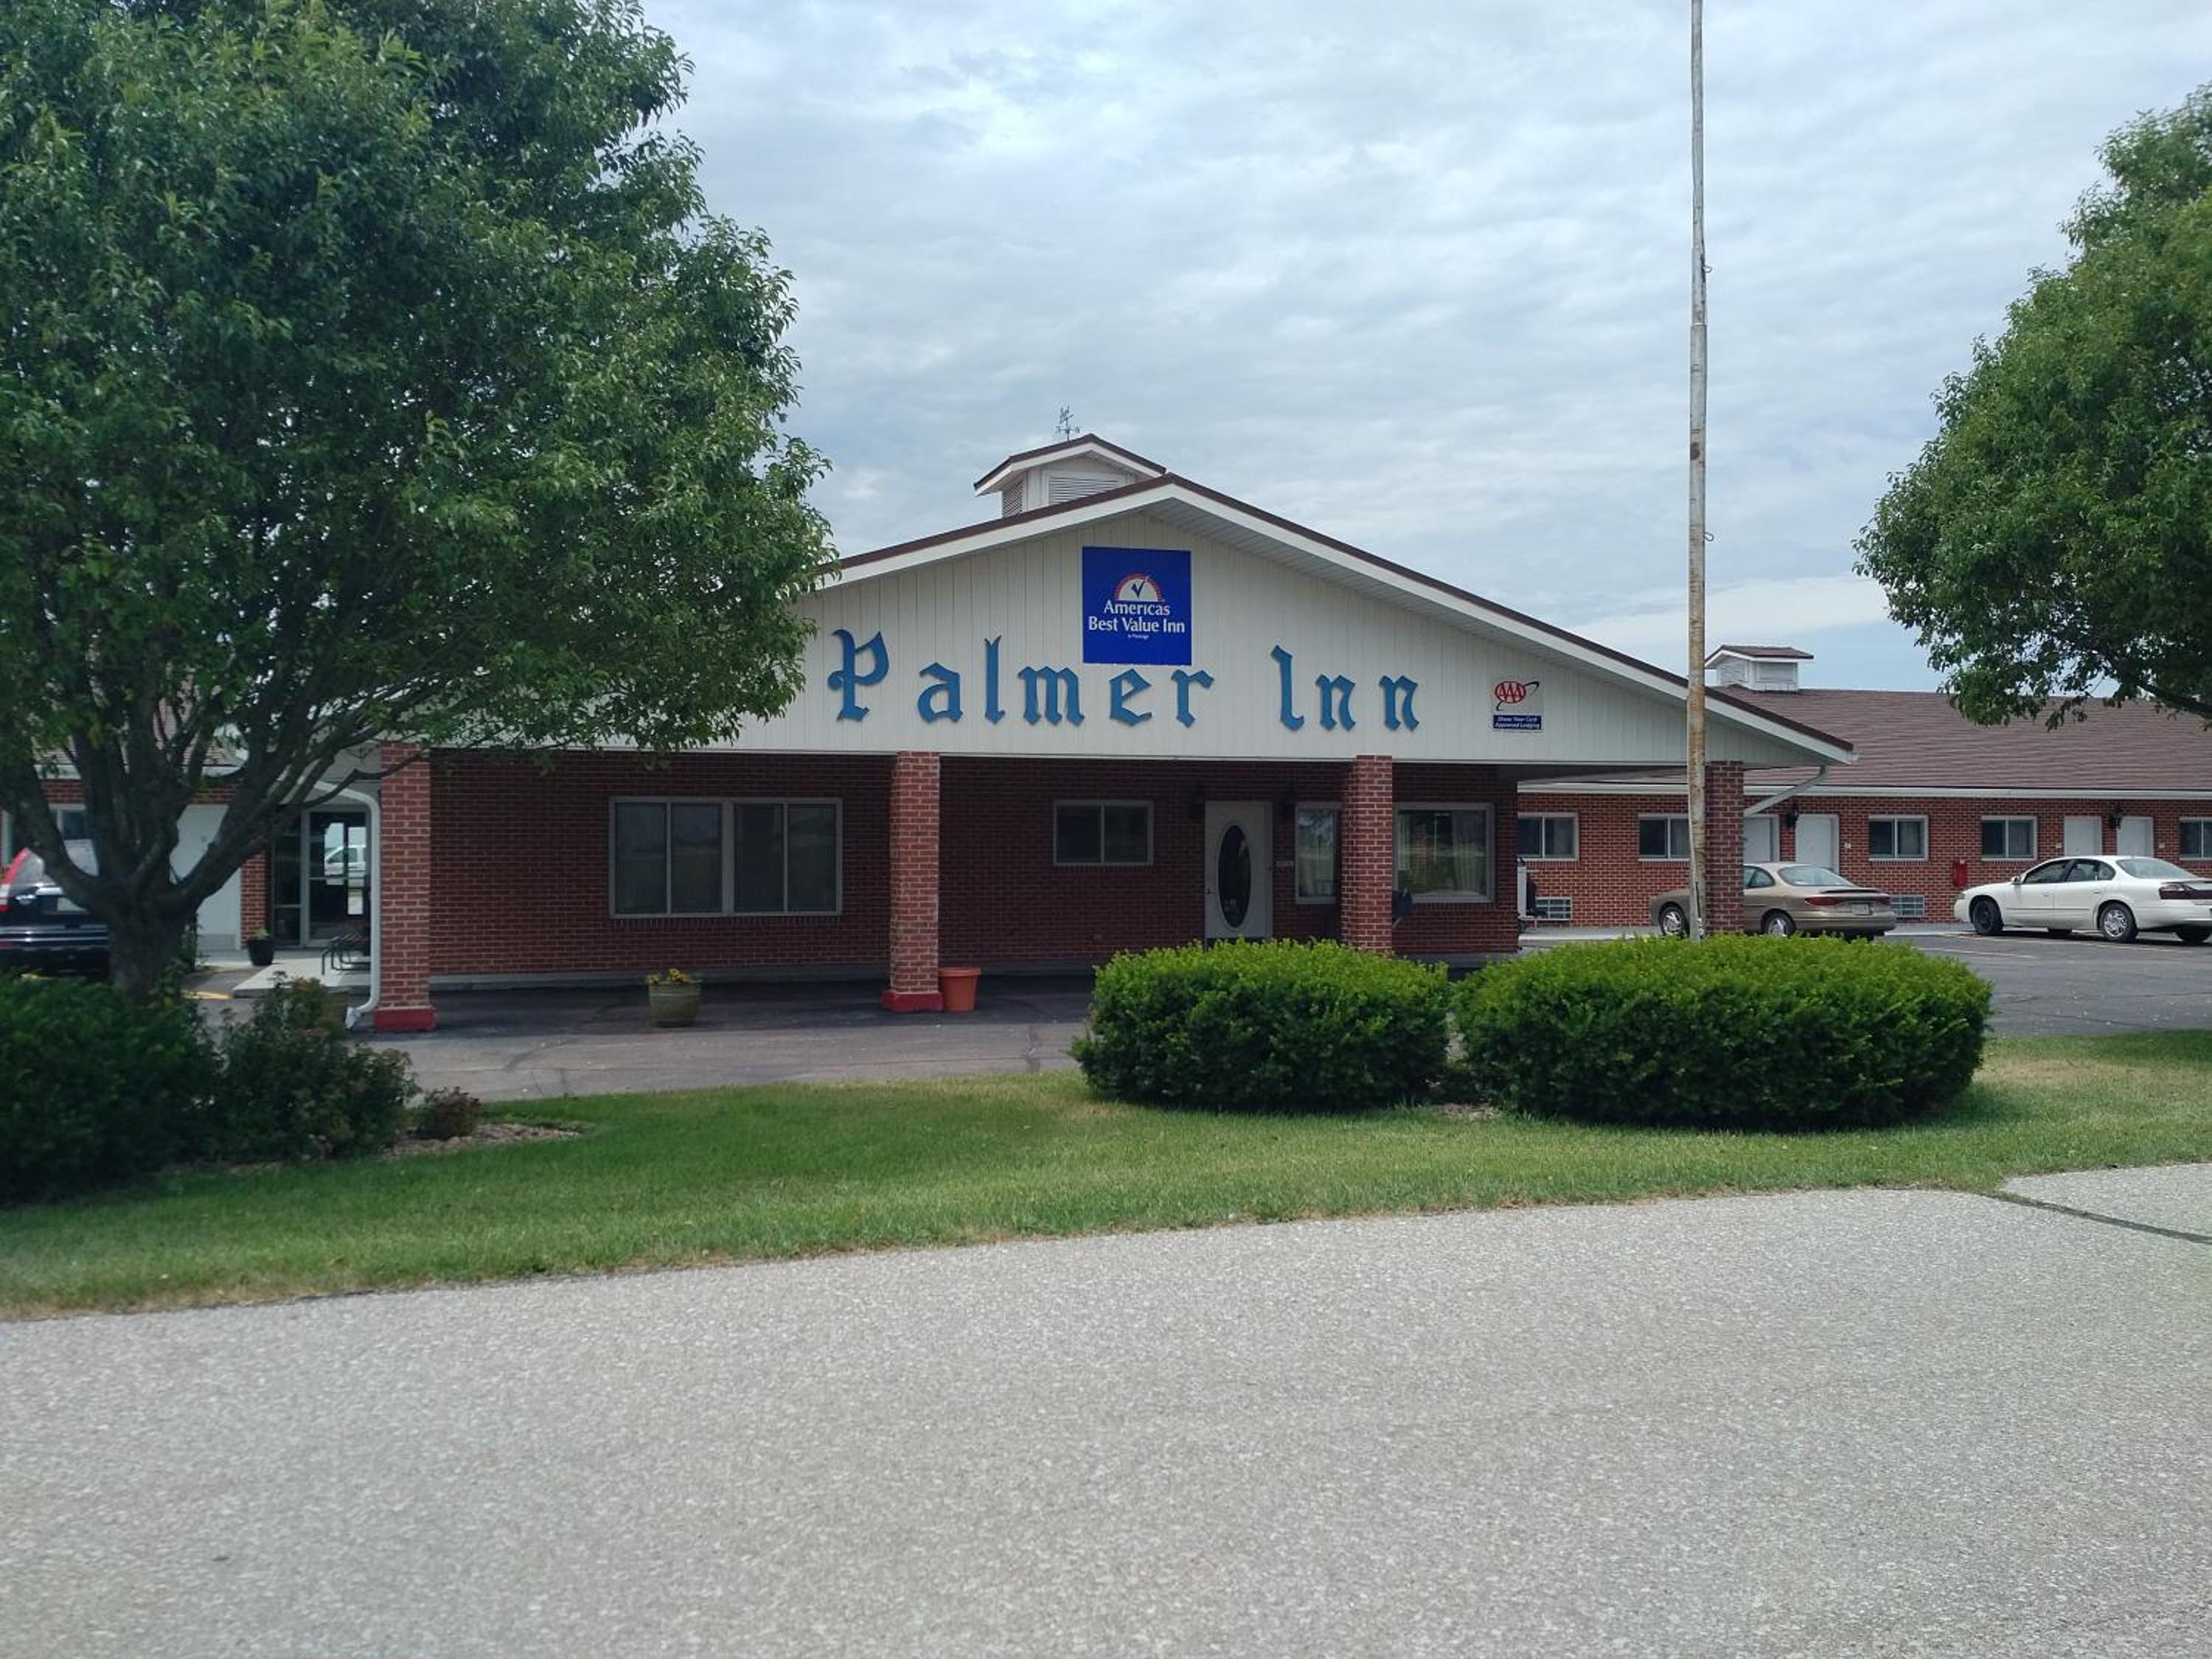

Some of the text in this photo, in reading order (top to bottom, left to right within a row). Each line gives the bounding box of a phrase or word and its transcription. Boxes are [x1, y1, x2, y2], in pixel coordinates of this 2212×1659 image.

[1104, 599, 1171, 616] Americas
[1088, 616, 1186, 633] Best Value Inn
[827, 629, 1420, 732] Palmer Inn
[1498, 683, 1524, 702] AAA
